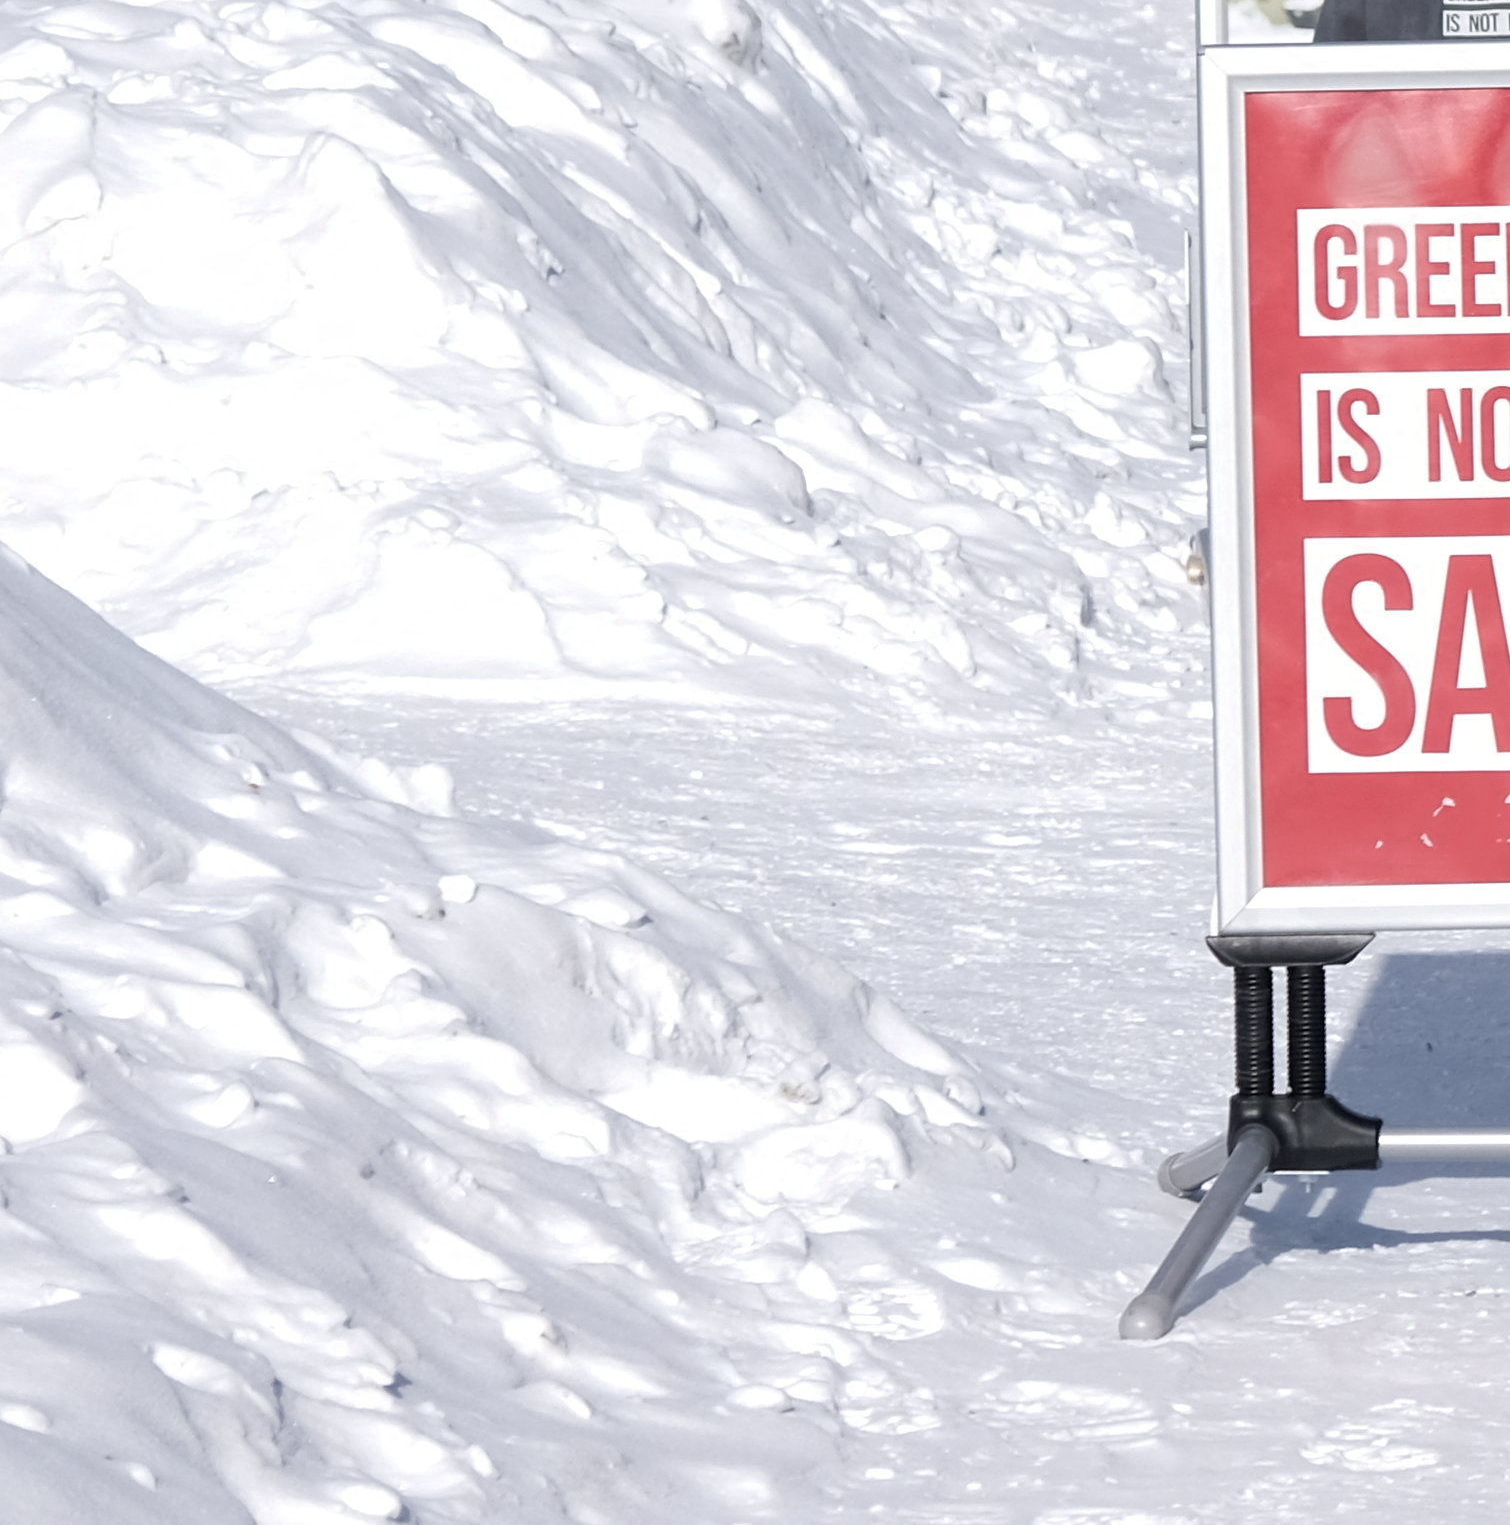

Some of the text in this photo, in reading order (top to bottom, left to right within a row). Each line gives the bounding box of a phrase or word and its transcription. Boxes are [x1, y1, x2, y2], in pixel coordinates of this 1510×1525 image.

[1446, 13, 1460, 33] IS
[1469, 13, 1499, 33] NOT
[1317, 389, 1381, 485] IS
